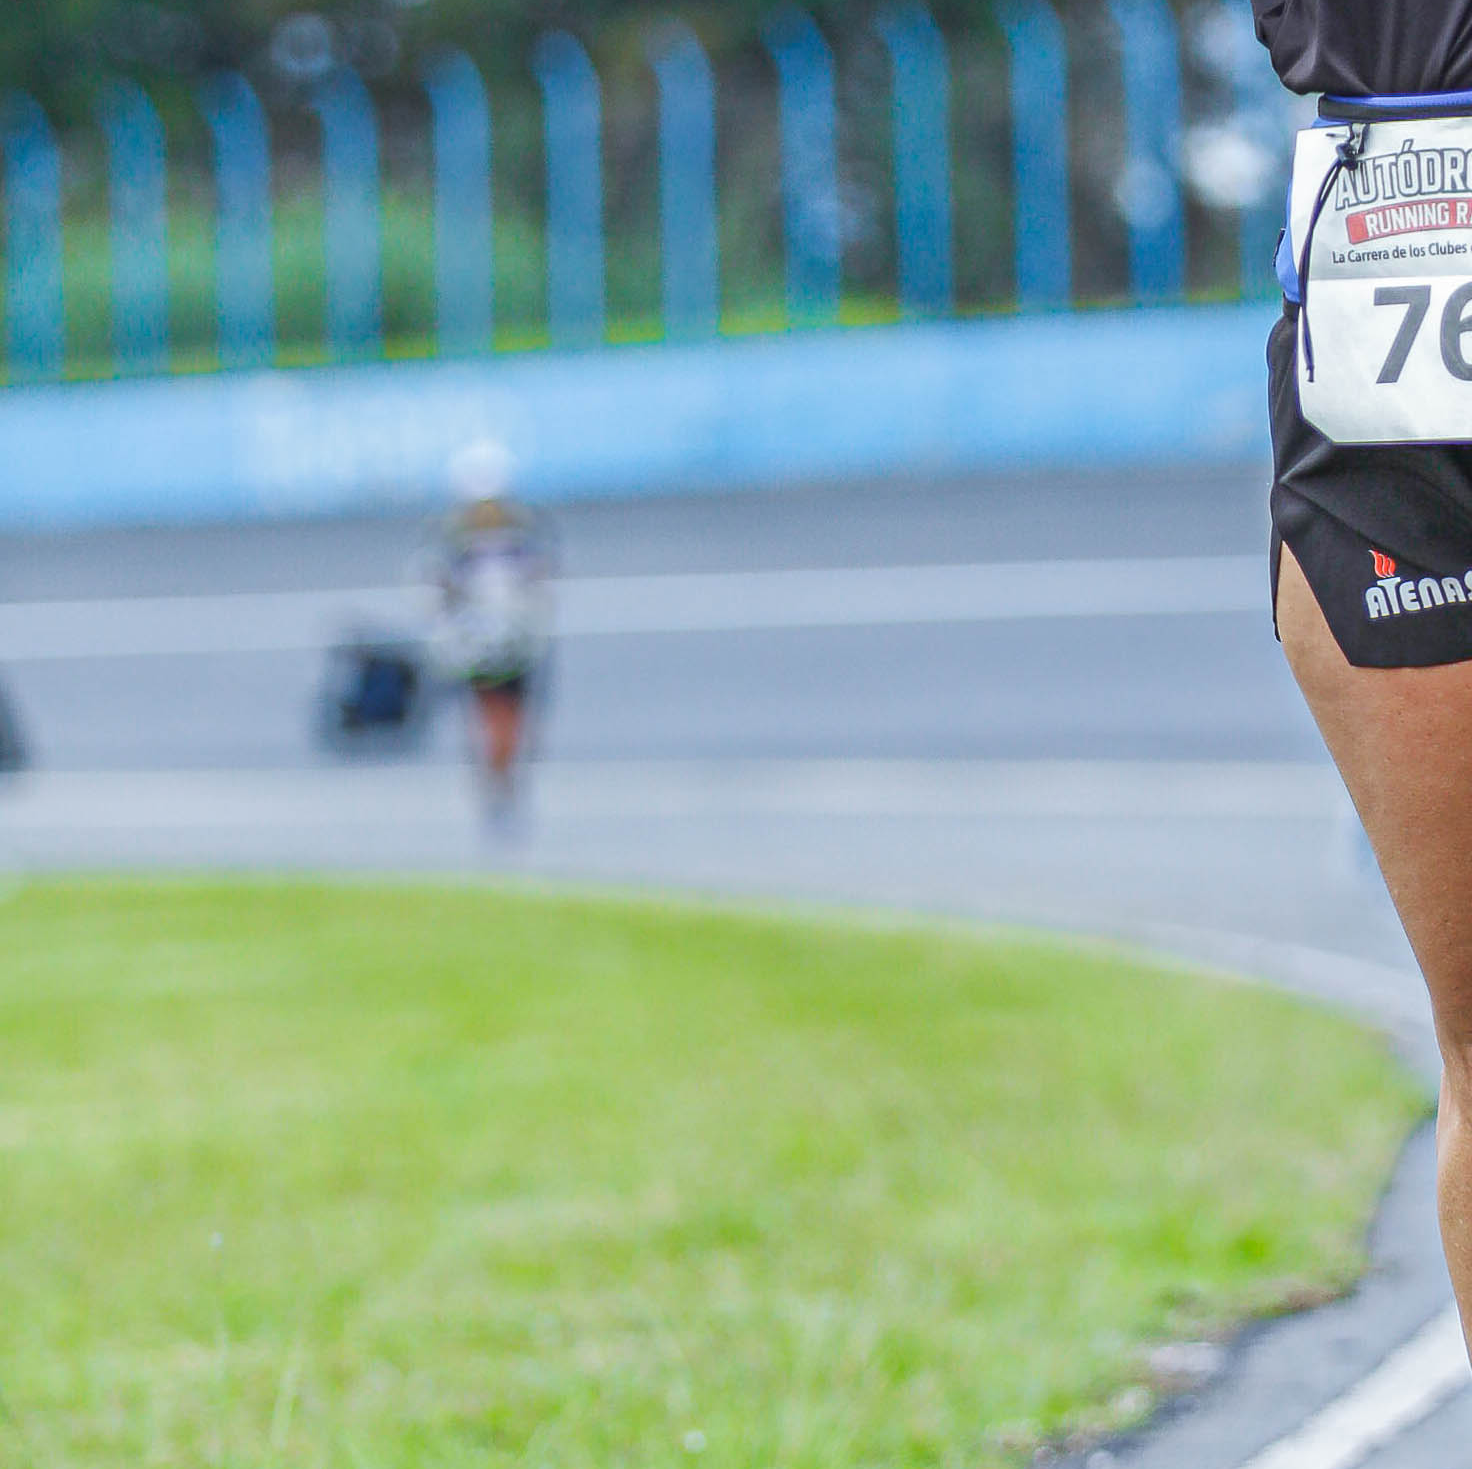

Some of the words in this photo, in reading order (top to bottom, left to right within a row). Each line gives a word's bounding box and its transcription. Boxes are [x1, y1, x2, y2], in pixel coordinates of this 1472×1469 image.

[1364, 202, 1450, 238] RUNNING
[1332, 250, 1346, 264] La
[1347, 249, 1390, 263] Carrera
[1392, 245, 1407, 259] de
[1409, 244, 1426, 258] los
[1428, 242, 1467, 256] Clubes
